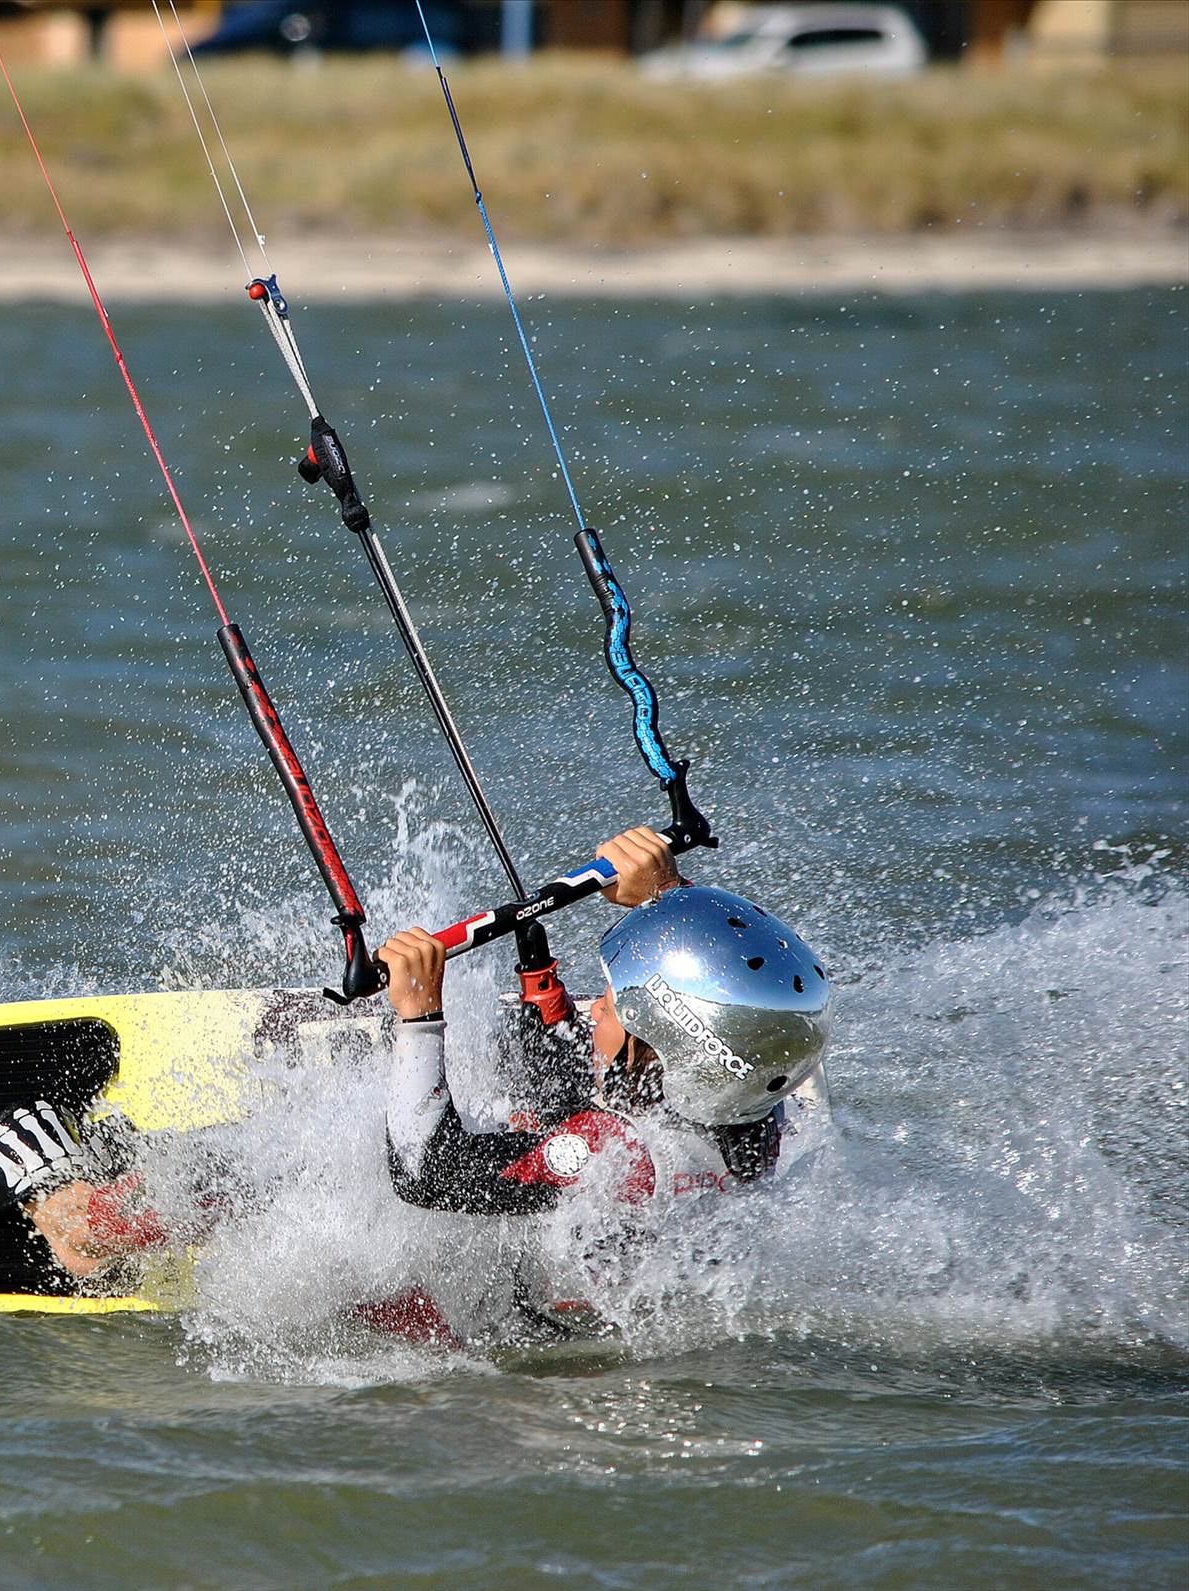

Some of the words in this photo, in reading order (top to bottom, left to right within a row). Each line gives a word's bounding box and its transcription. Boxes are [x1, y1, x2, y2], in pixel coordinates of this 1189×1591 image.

[609, 648, 653, 721] OZONE
[284, 753, 331, 848] OZONE
[516, 896, 555, 921] OZONE
